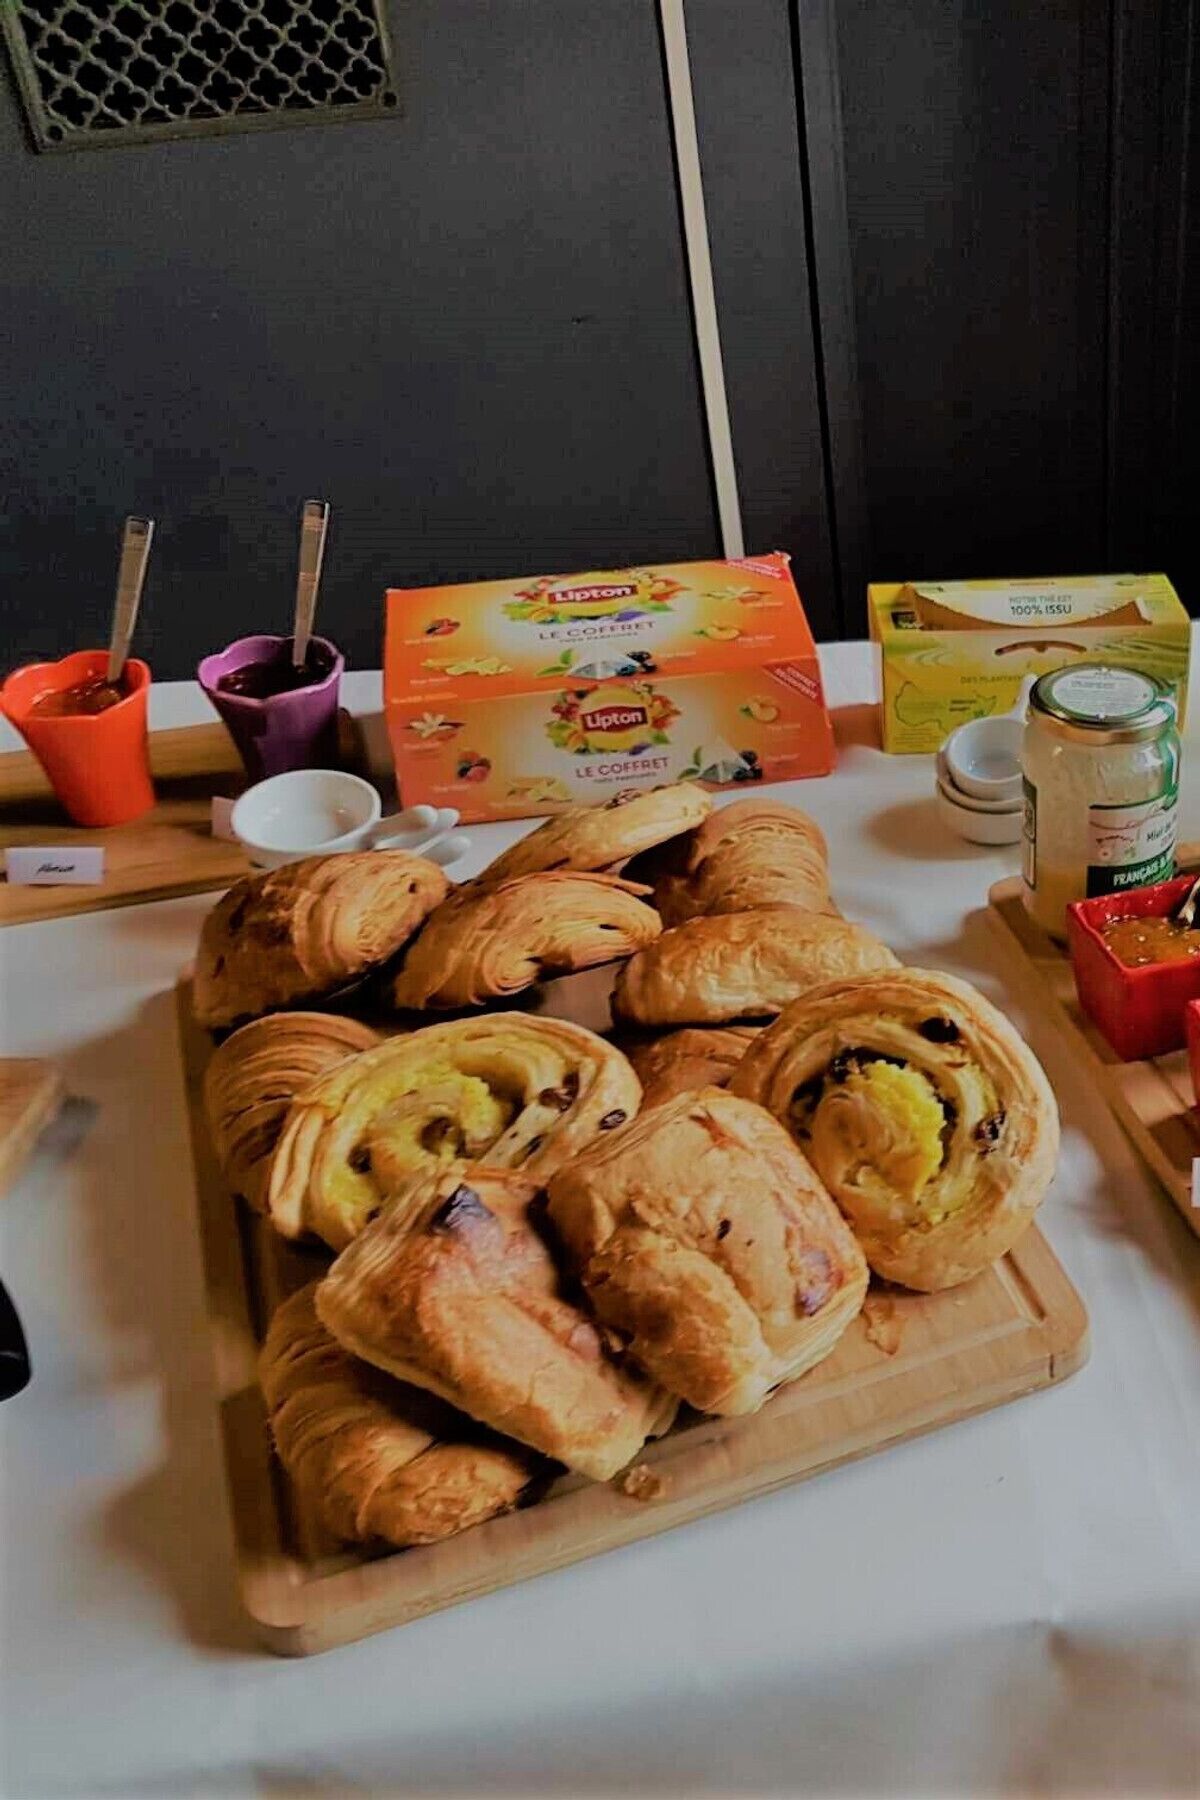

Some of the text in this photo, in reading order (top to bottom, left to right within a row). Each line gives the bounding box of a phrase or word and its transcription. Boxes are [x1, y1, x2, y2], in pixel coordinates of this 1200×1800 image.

[553, 584, 634, 604] Lipton
[1010, 603, 1073, 616] 100% ISSU
[538, 629, 561, 641] LE
[564, 620, 658, 638] COFFRET
[585, 708, 645, 732] Lipton
[575, 765, 597, 779] LE
[597, 756, 670, 778] COFFRET
